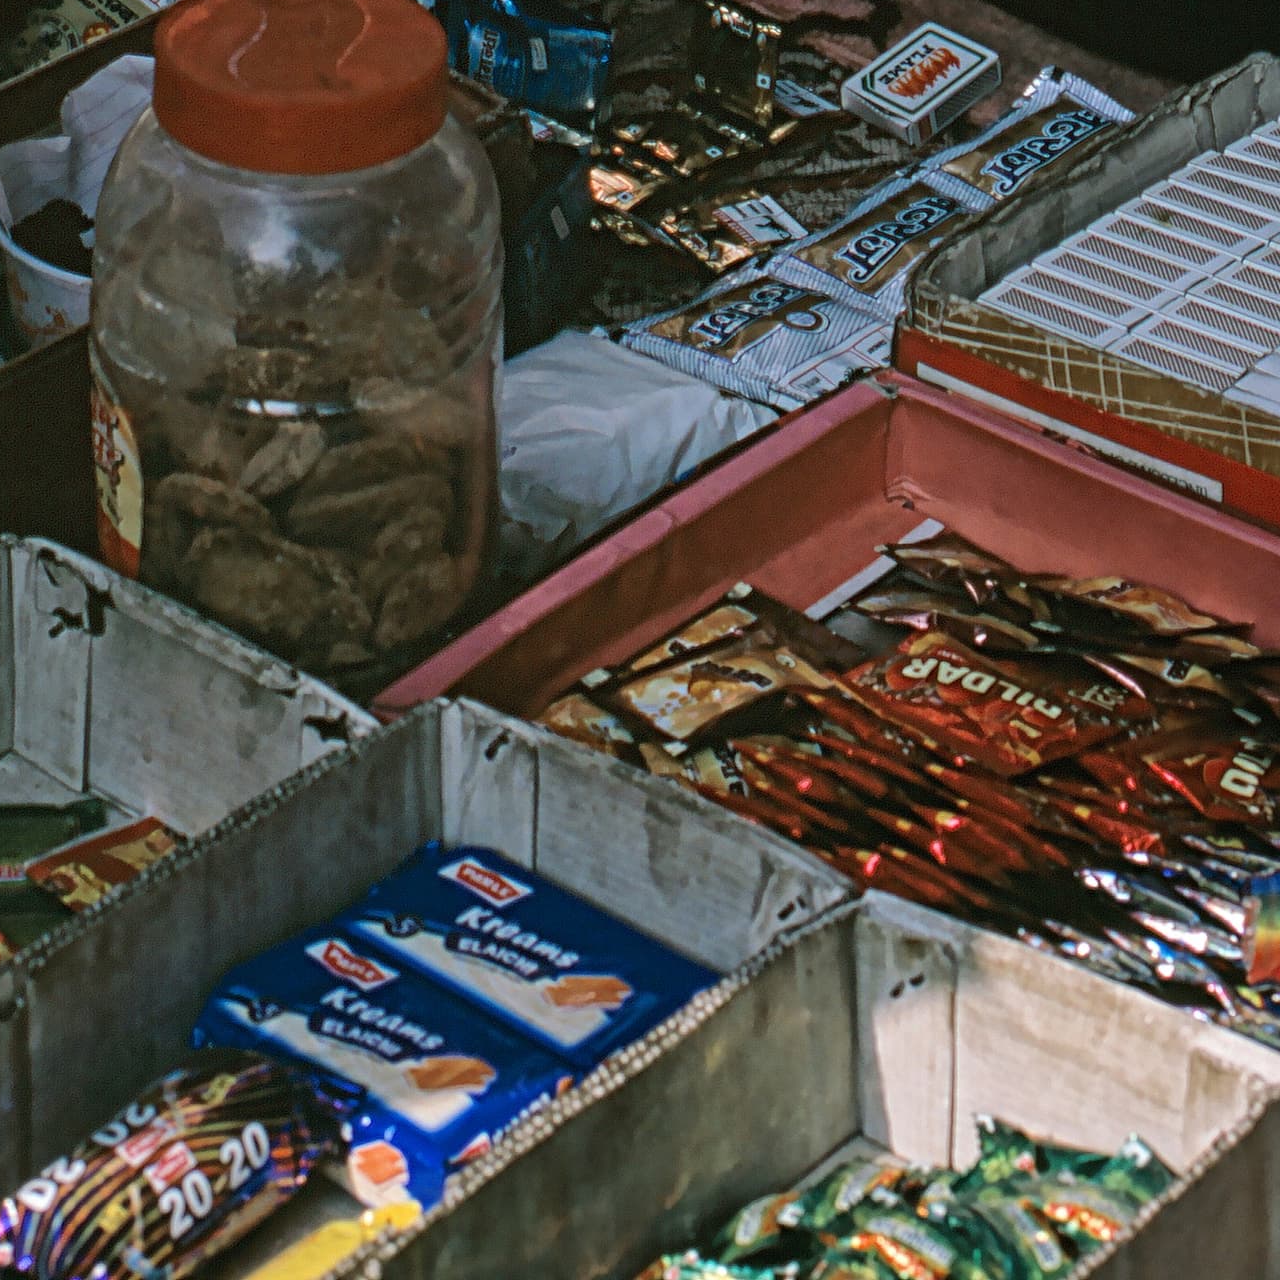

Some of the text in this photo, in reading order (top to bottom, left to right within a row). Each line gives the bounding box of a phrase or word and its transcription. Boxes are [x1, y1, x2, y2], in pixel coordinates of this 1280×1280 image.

[878, 43, 936, 85] FLAME
[902, 656, 1064, 721] DILDAR
[455, 904, 581, 969] Kreams
[458, 937, 539, 977] ELAICHI
[319, 986, 445, 1051] Kreams
[321, 1016, 404, 1059] ELAICHI
